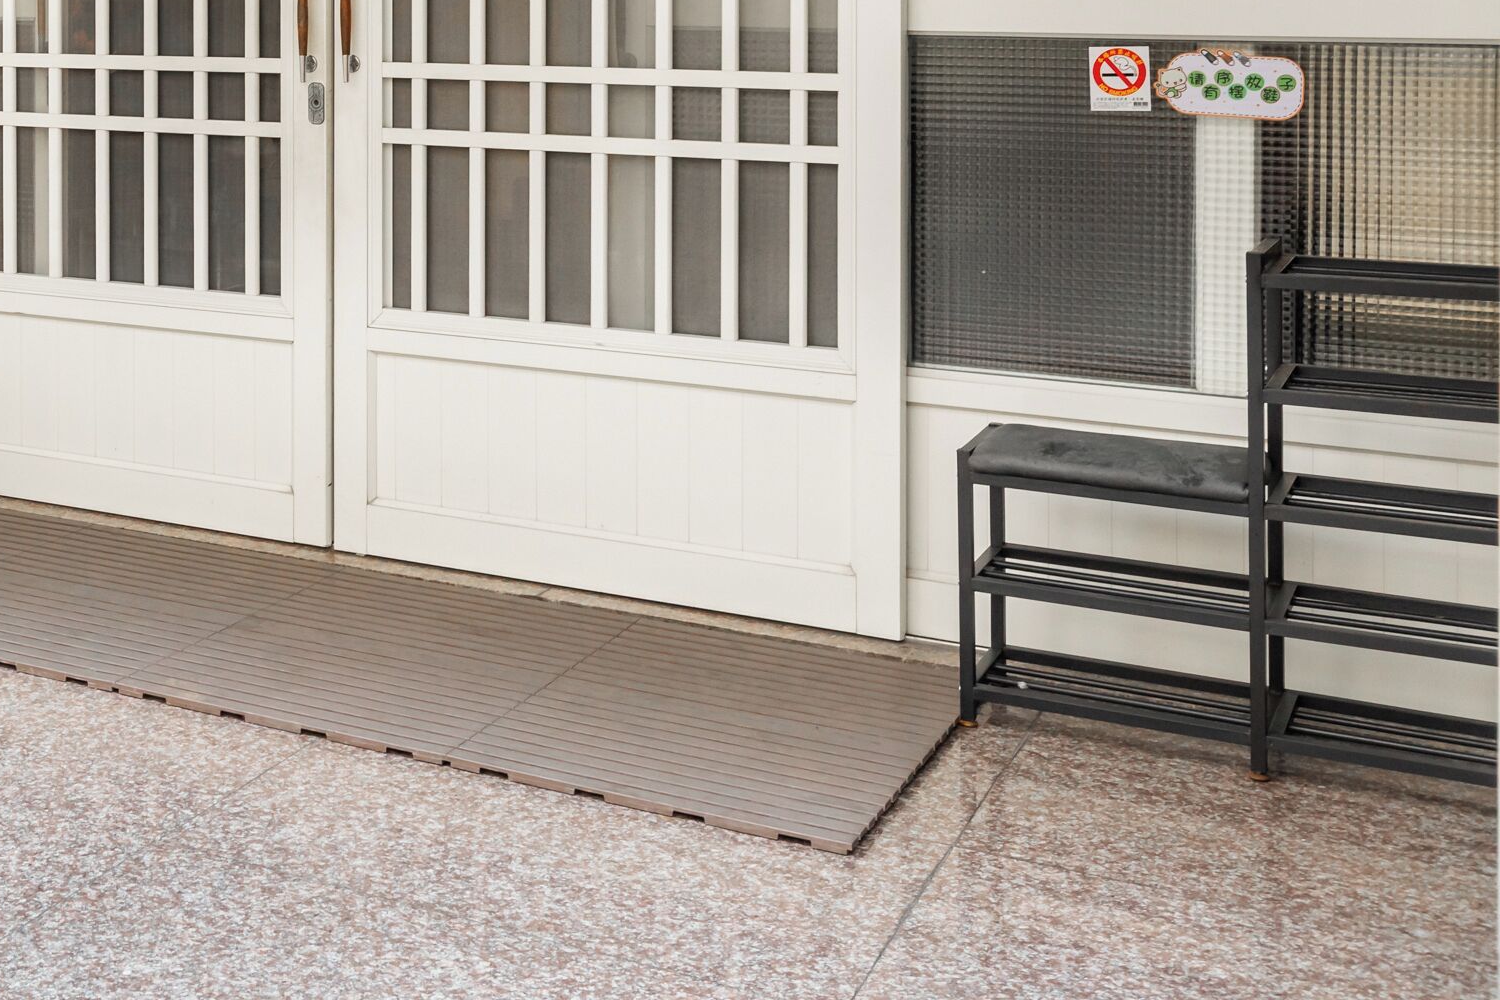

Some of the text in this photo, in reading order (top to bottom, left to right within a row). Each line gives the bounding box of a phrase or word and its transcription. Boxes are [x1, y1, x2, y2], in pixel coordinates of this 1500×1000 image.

[1187, 70, 1296, 102] 请有序摆放鞋子
